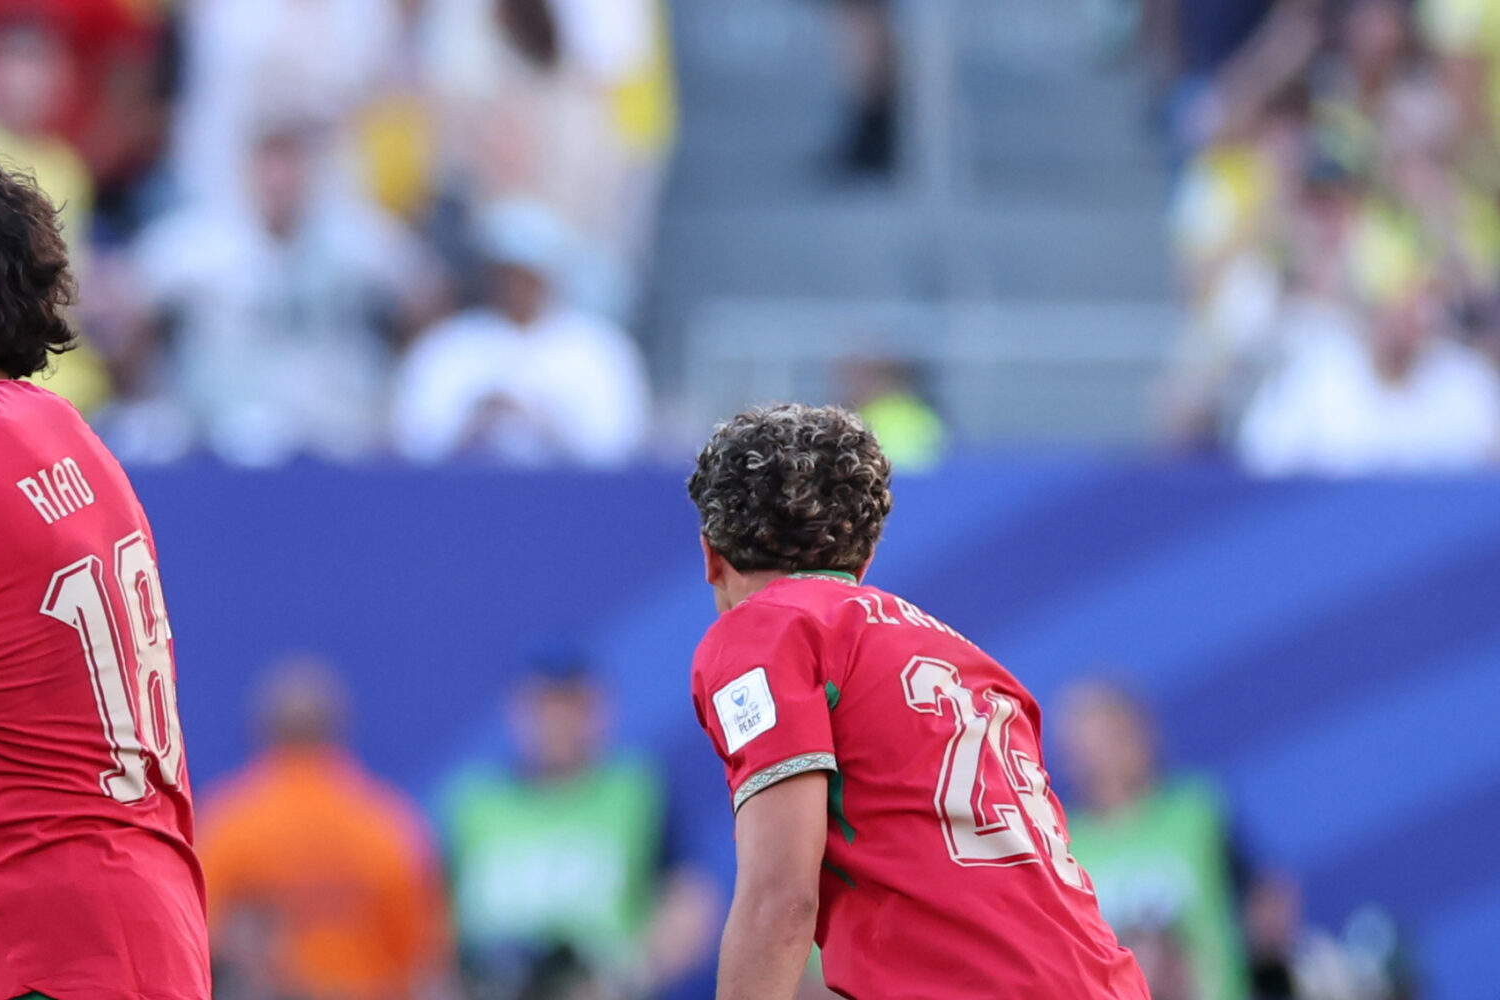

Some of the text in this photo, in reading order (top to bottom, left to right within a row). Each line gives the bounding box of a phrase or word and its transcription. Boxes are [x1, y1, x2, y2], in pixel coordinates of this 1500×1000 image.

[16, 456, 95, 525] RIAD
[38, 529, 184, 807] 18
[738, 711, 761, 735] PEACE
[900, 655, 1094, 895] 24
